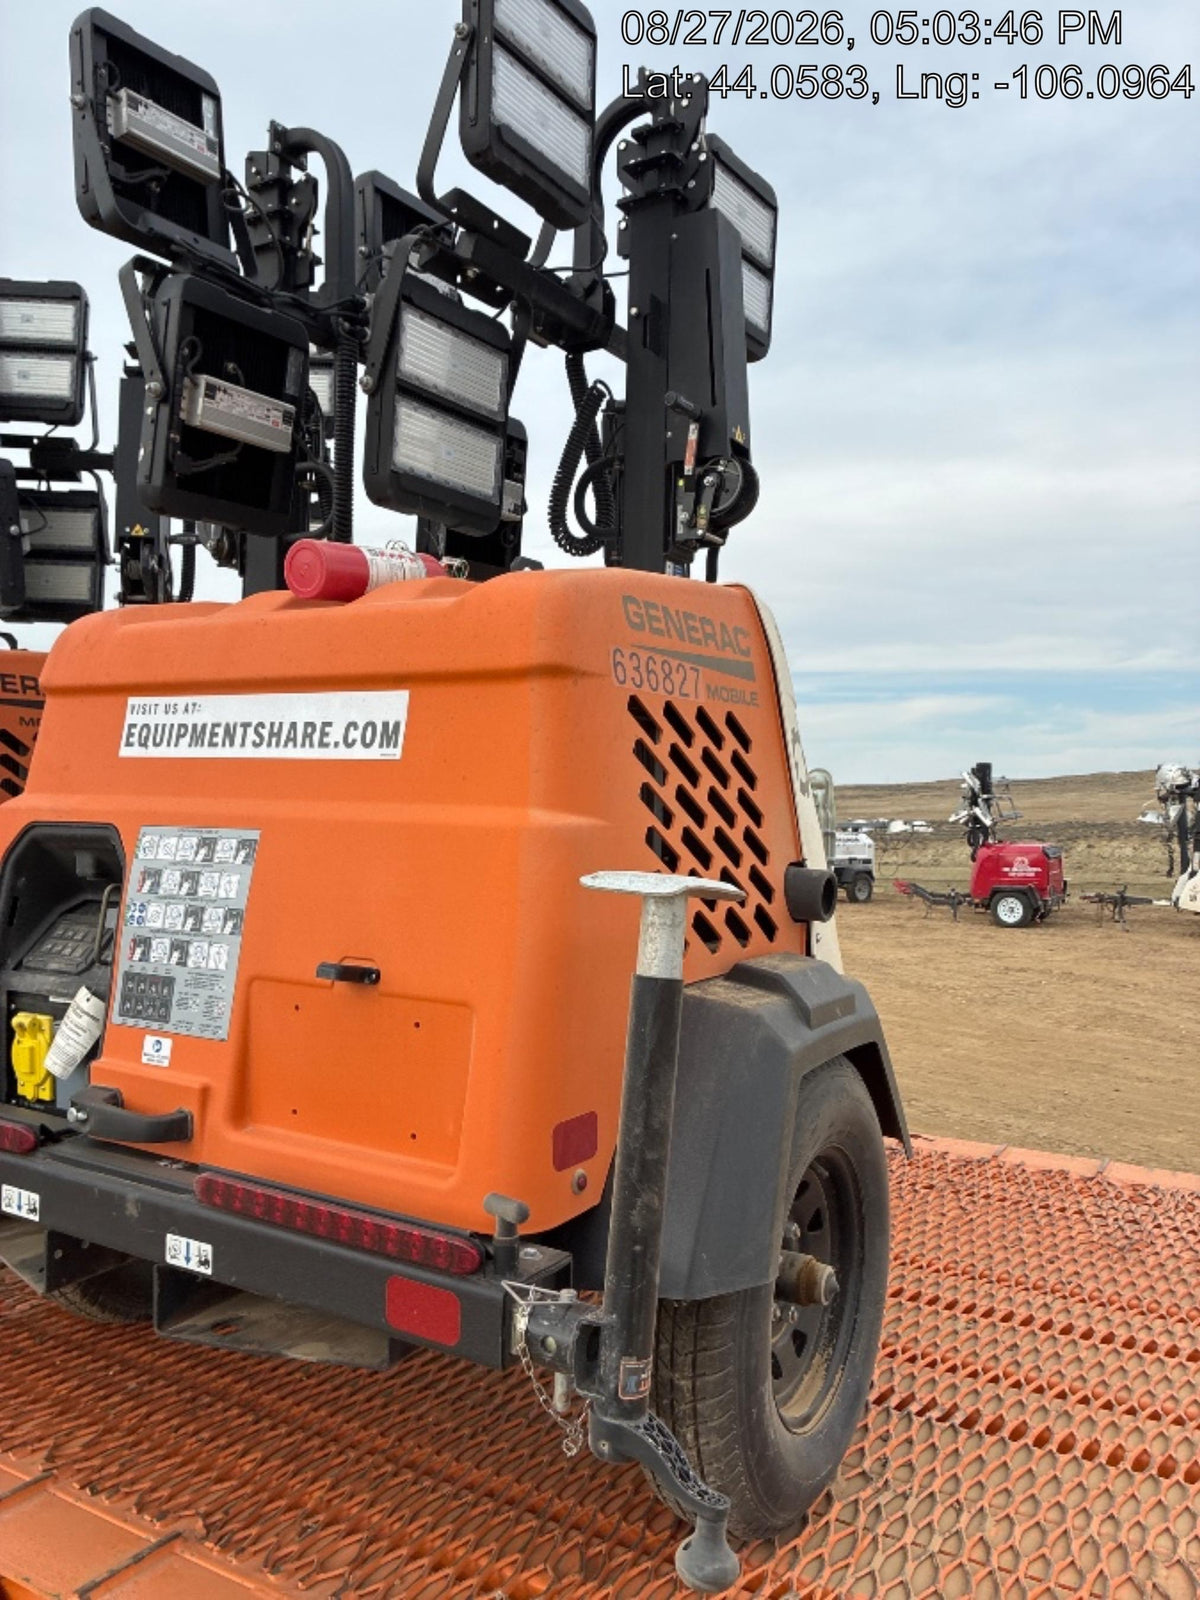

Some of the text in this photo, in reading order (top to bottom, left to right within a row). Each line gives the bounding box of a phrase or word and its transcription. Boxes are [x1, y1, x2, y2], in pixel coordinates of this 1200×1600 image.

[622, 595, 751, 657] GENERAC
[612, 647, 701, 699] 636827
[130, 702, 202, 715] VISIT US AT:
[705, 683, 760, 706] MOBILE
[124, 721, 401, 750] EQUIPMENTSHARE.COM
